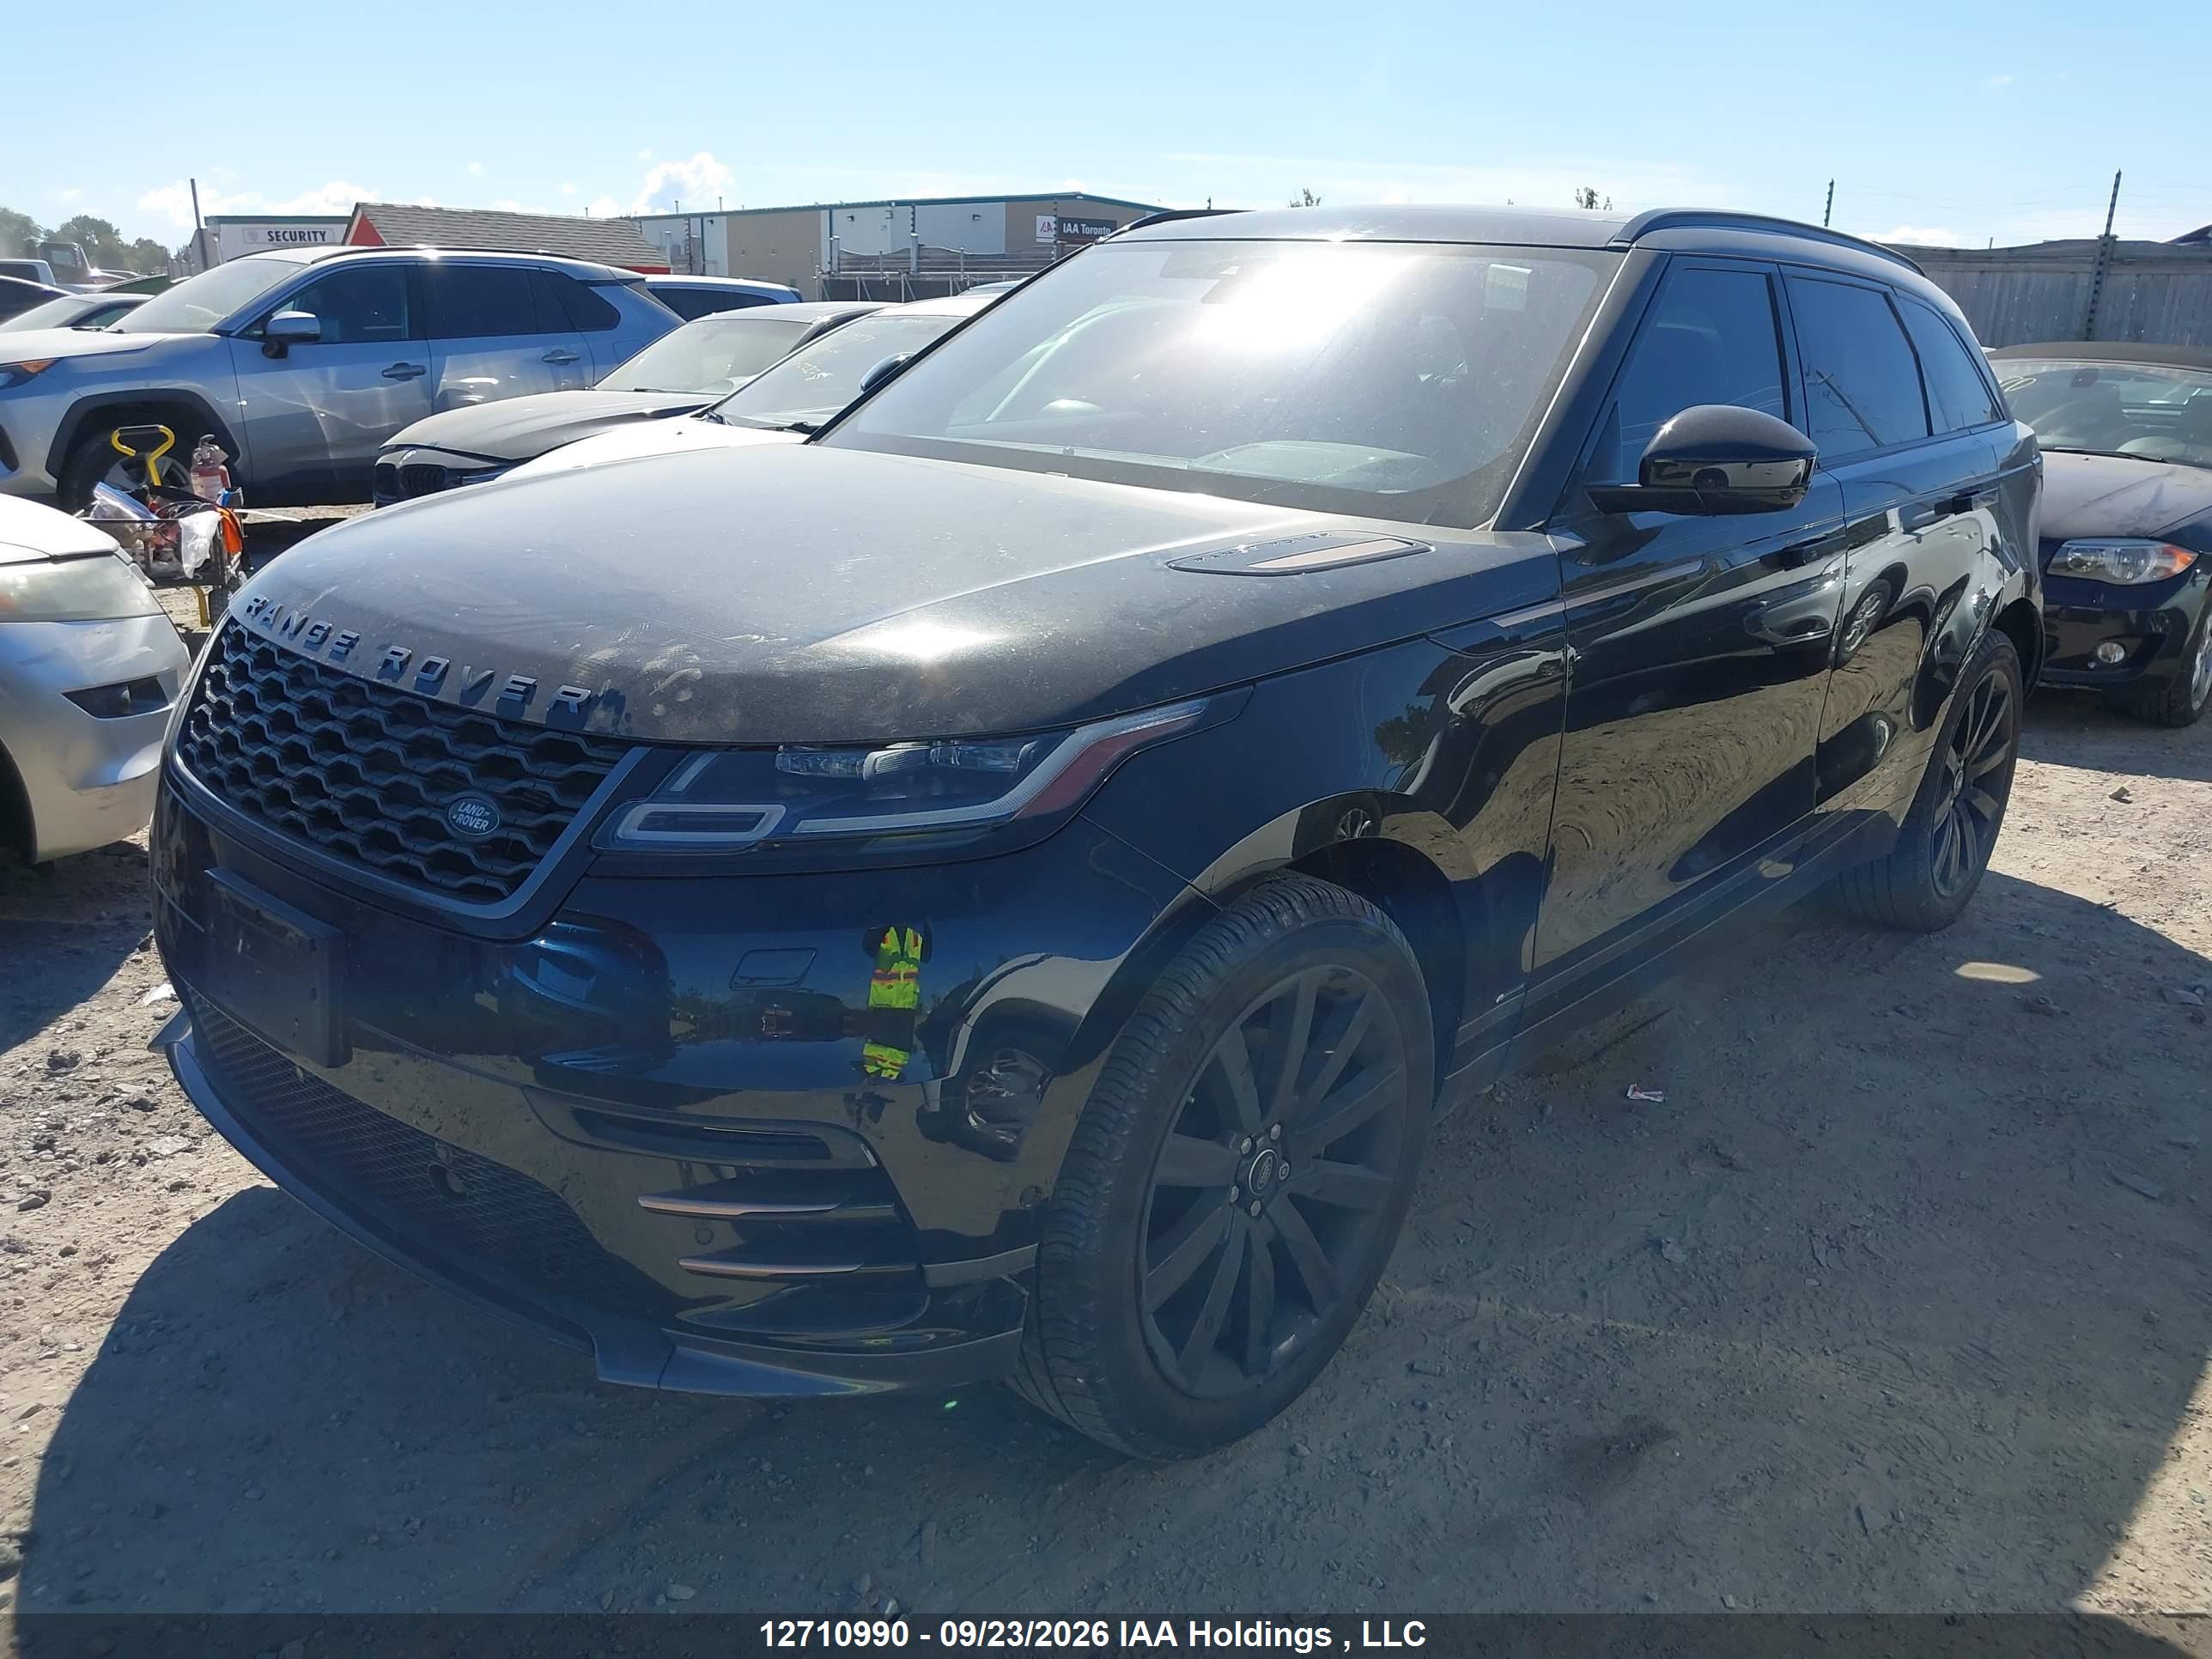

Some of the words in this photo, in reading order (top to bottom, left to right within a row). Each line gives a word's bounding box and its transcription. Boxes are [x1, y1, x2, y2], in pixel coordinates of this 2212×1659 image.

[267, 230, 326, 242] SECURITY
[1063, 222, 1079, 234] IAA
[1080, 224, 1111, 235] Toronto
[246, 597, 360, 656] RANGE
[380, 645, 592, 715] ROVER
[458, 802, 485, 817] LAND
[455, 813, 489, 831] ROVER
